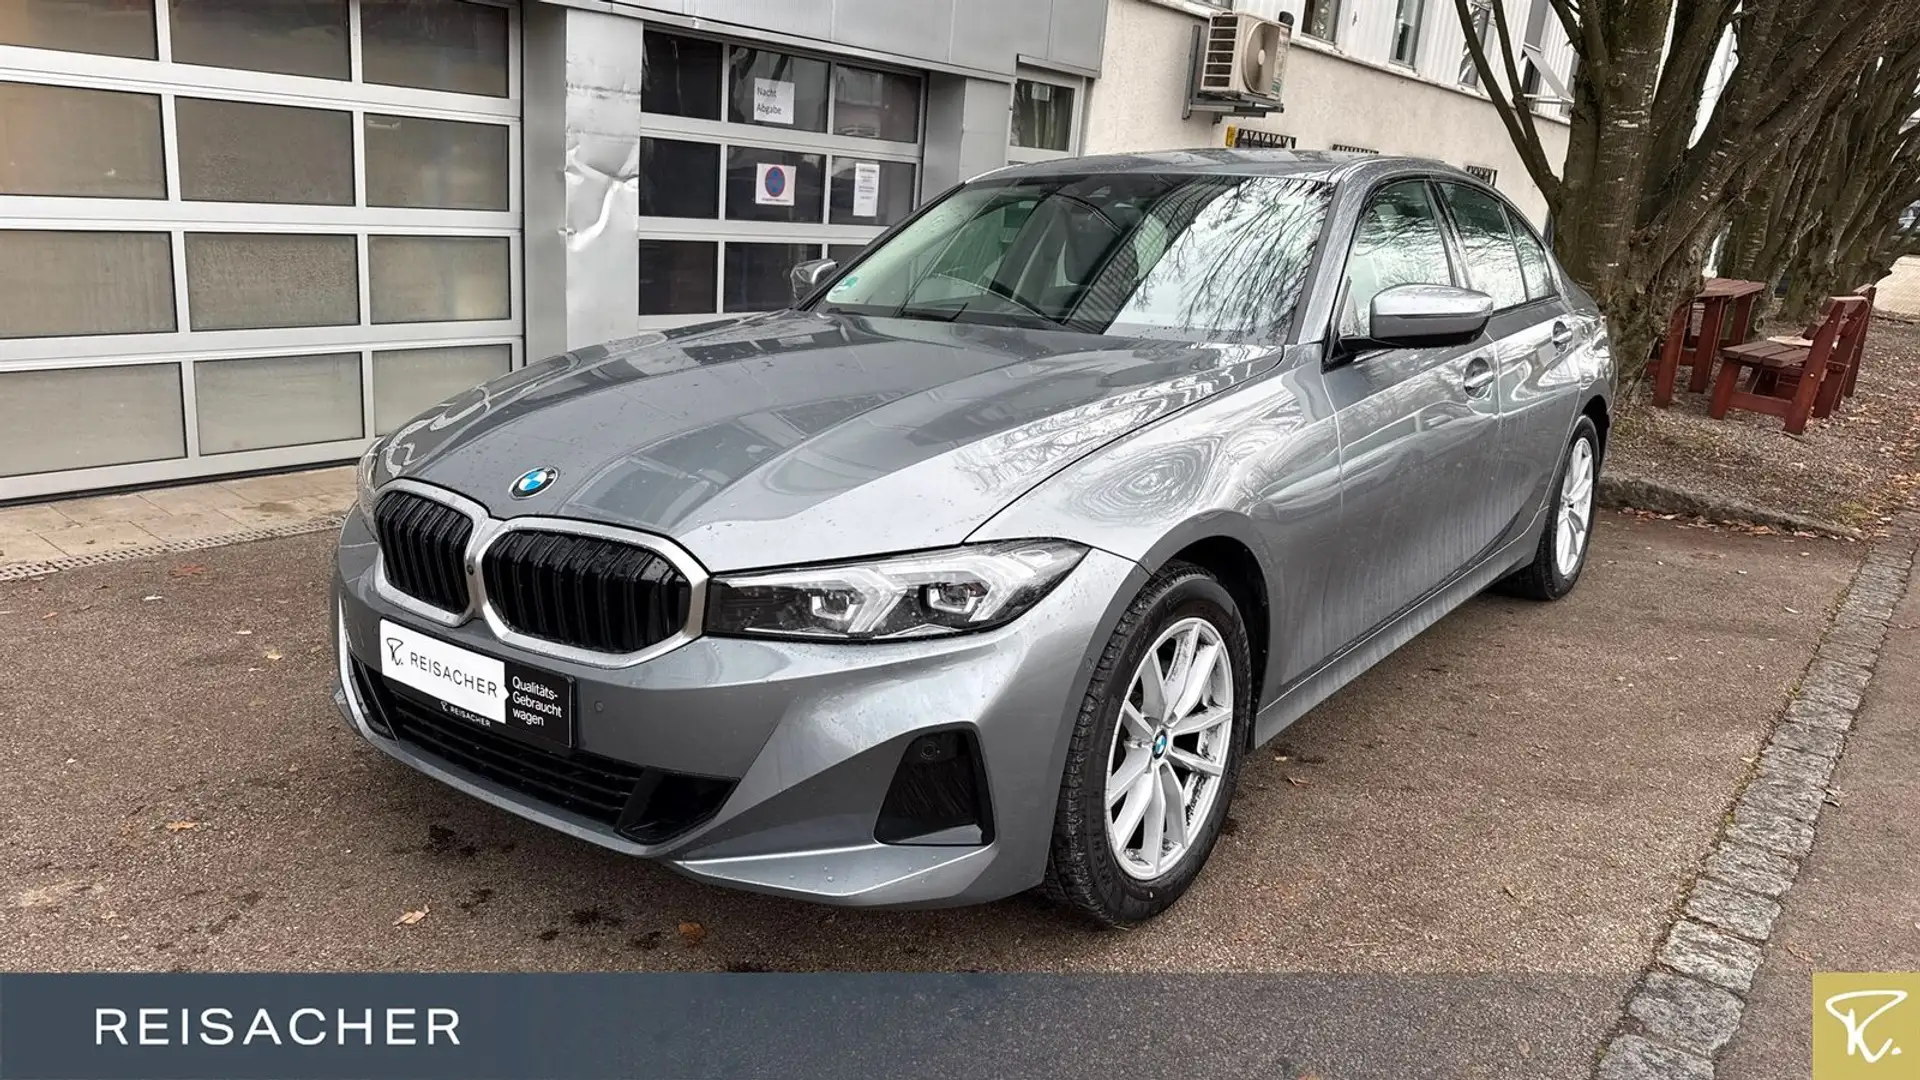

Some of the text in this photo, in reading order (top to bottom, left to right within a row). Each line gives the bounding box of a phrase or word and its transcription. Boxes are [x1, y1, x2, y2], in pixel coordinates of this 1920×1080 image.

[757, 86, 777, 98] Nacht
[756, 103, 782, 115] Abgabe
[410, 652, 498, 698] REISACHER
[512, 675, 559, 699] Qualitäts-
[512, 690, 562, 718] Gebraucht
[450, 708, 491, 727] REISACHER
[512, 709, 544, 727] wagen
